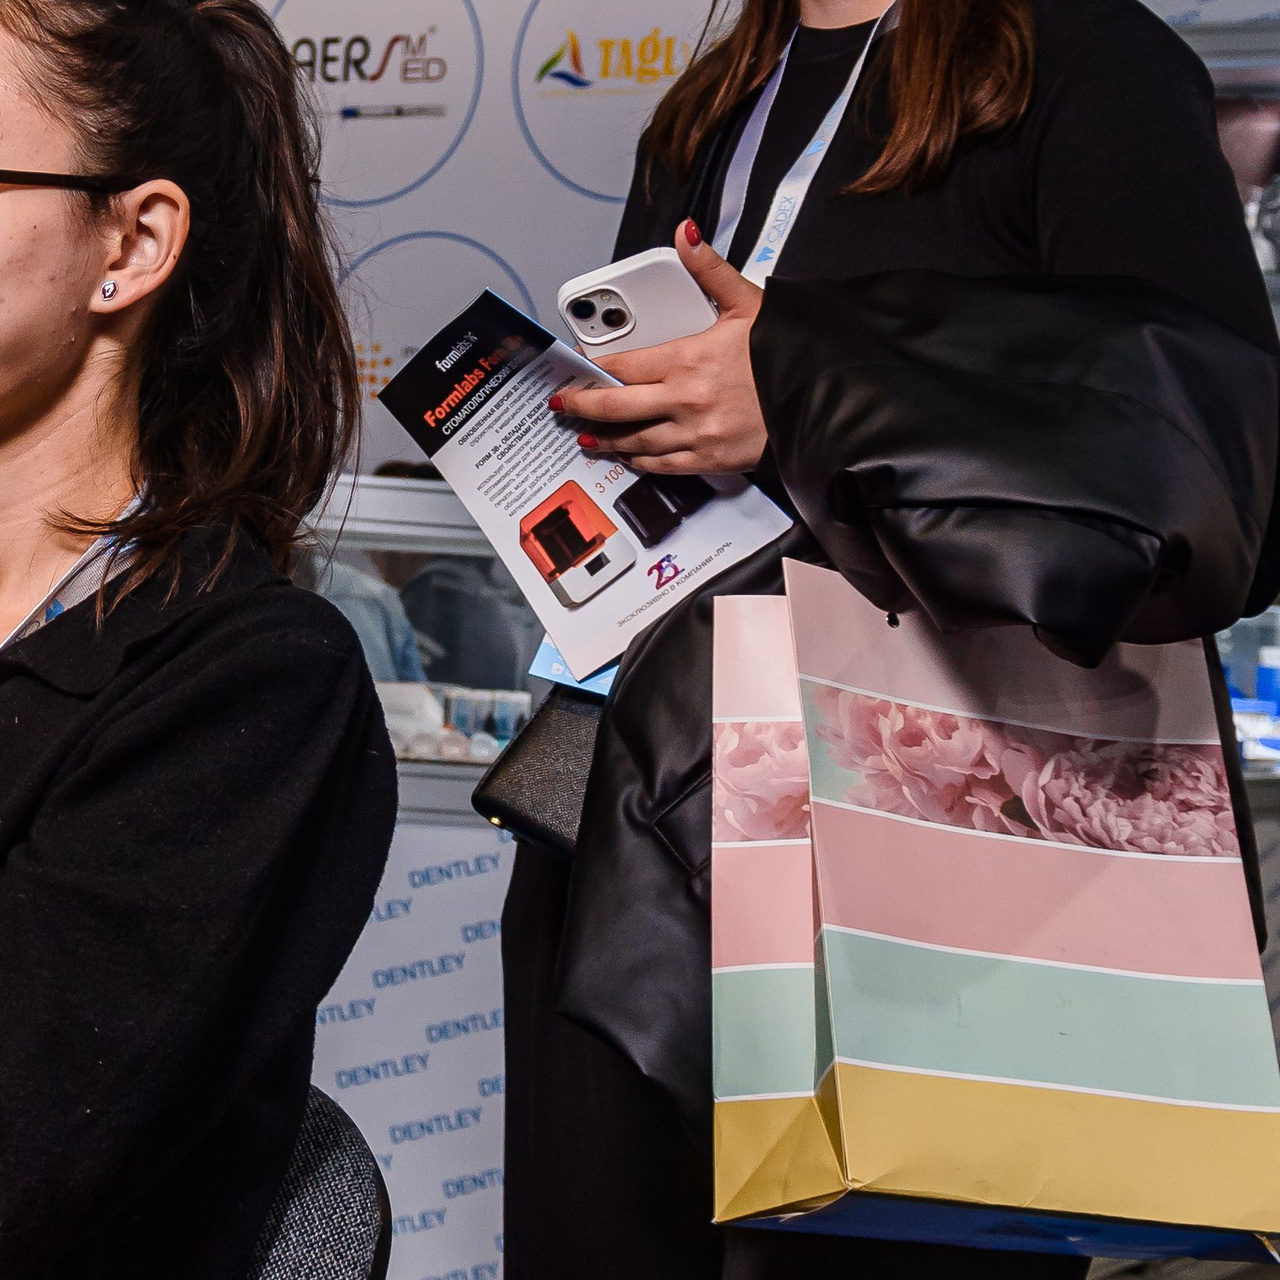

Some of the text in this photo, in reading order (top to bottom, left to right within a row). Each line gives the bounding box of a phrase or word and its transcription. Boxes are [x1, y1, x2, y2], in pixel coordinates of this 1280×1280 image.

[769, 196, 795, 244] CADEX
[434, 335, 473, 374] formlabs
[422, 364, 487, 429] Formlabs
[474, 451, 493, 470] FORM
[500, 417, 529, 445] ОБЛАДАЕТ
[526, 401, 545, 420] ВСЕМИ
[495, 424, 533, 462] СВОЙСТВАМИ
[594, 481, 607, 494] 3
[602, 463, 626, 486] 100
[616, 588, 670, 628] ЭКСКЛЮЗИВНО
[675, 555, 714, 587] КОМПАНИИ
[408, 852, 500, 888] DENTLEY
[372, 951, 466, 988] DENTLEY
[317, 997, 376, 1025] NTLEY
[425, 1007, 503, 1044] DENTLE
[335, 1053, 429, 1090] DENTLEY
[389, 1106, 483, 1145] DENTLEY
